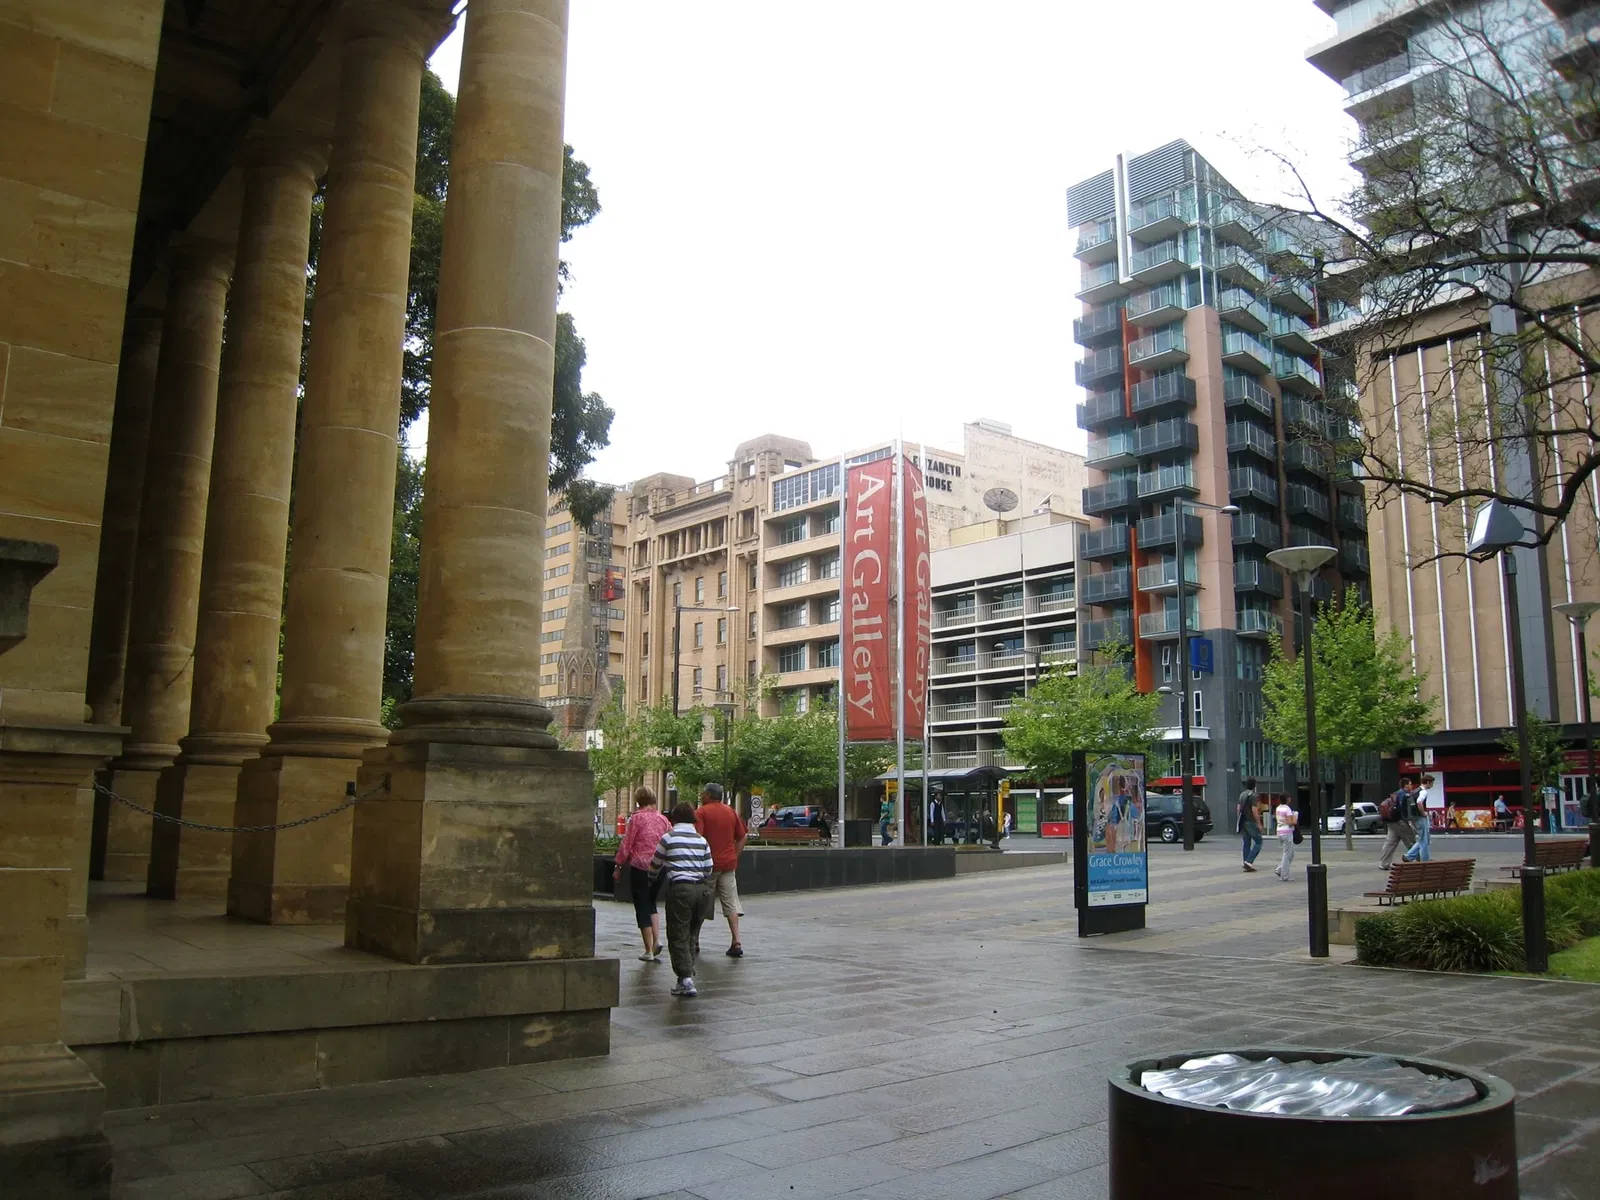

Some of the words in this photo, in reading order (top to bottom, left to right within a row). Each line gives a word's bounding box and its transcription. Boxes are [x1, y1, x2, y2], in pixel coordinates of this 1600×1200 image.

[853, 470, 885, 544] Art
[909, 466, 926, 545] Art
[847, 549, 883, 719] Gallery
[907, 552, 930, 720] Gallery
[1090, 855, 1112, 868] Grace
[1113, 853, 1143, 868] Crowley
